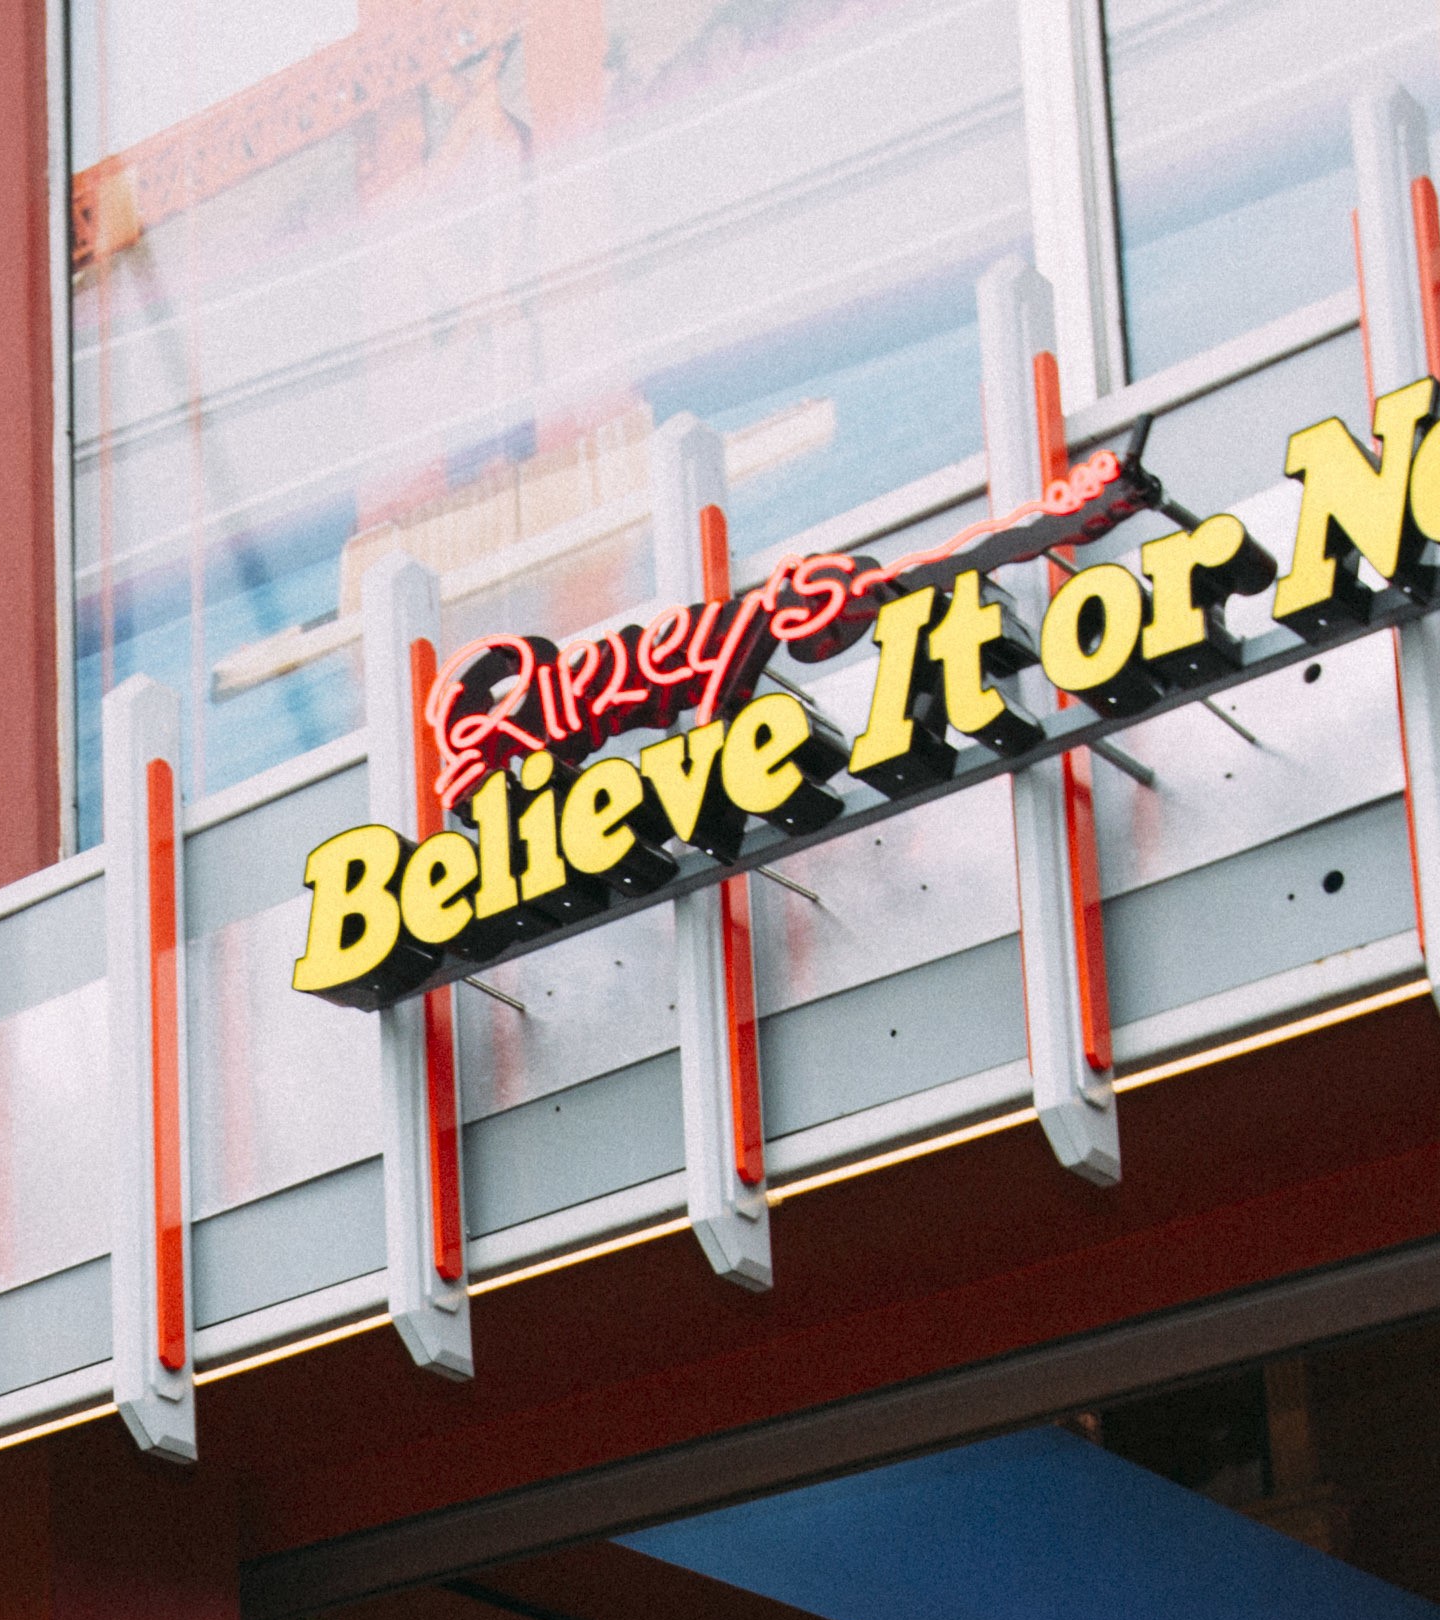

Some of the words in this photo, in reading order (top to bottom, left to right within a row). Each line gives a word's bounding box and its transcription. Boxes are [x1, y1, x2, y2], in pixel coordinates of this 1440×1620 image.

[291, 693, 810, 992] Believe
[848, 568, 1006, 777] It
[1040, 512, 1249, 694] or
